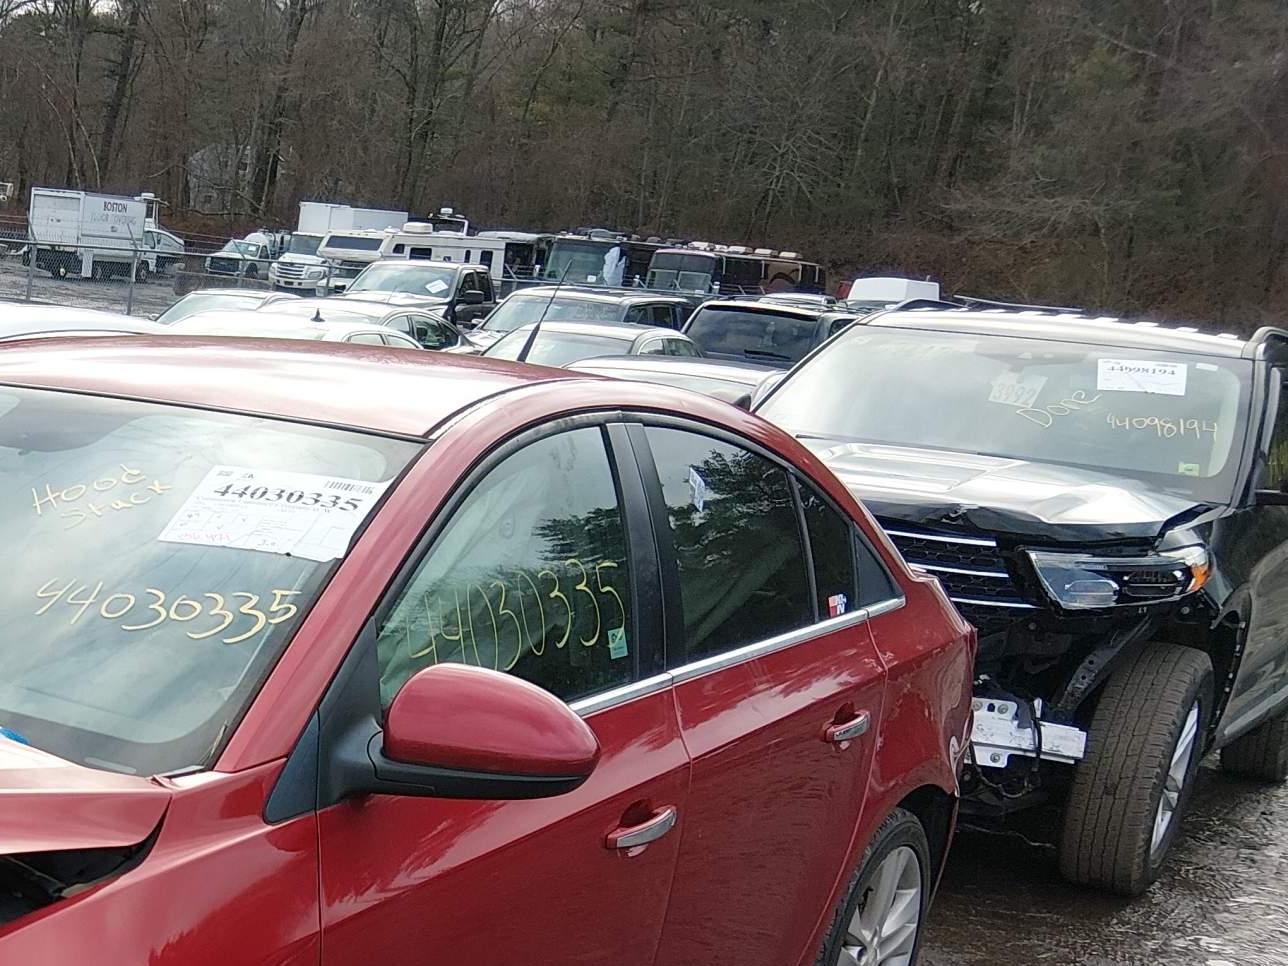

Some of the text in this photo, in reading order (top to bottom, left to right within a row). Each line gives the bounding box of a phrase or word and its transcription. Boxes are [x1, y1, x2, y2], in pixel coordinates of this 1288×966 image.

[103, 201, 128, 213] BOSTON
[1107, 412, 1218, 441] 44098194
[213, 483, 363, 512] 44030335
[34, 577, 302, 644] 44030335
